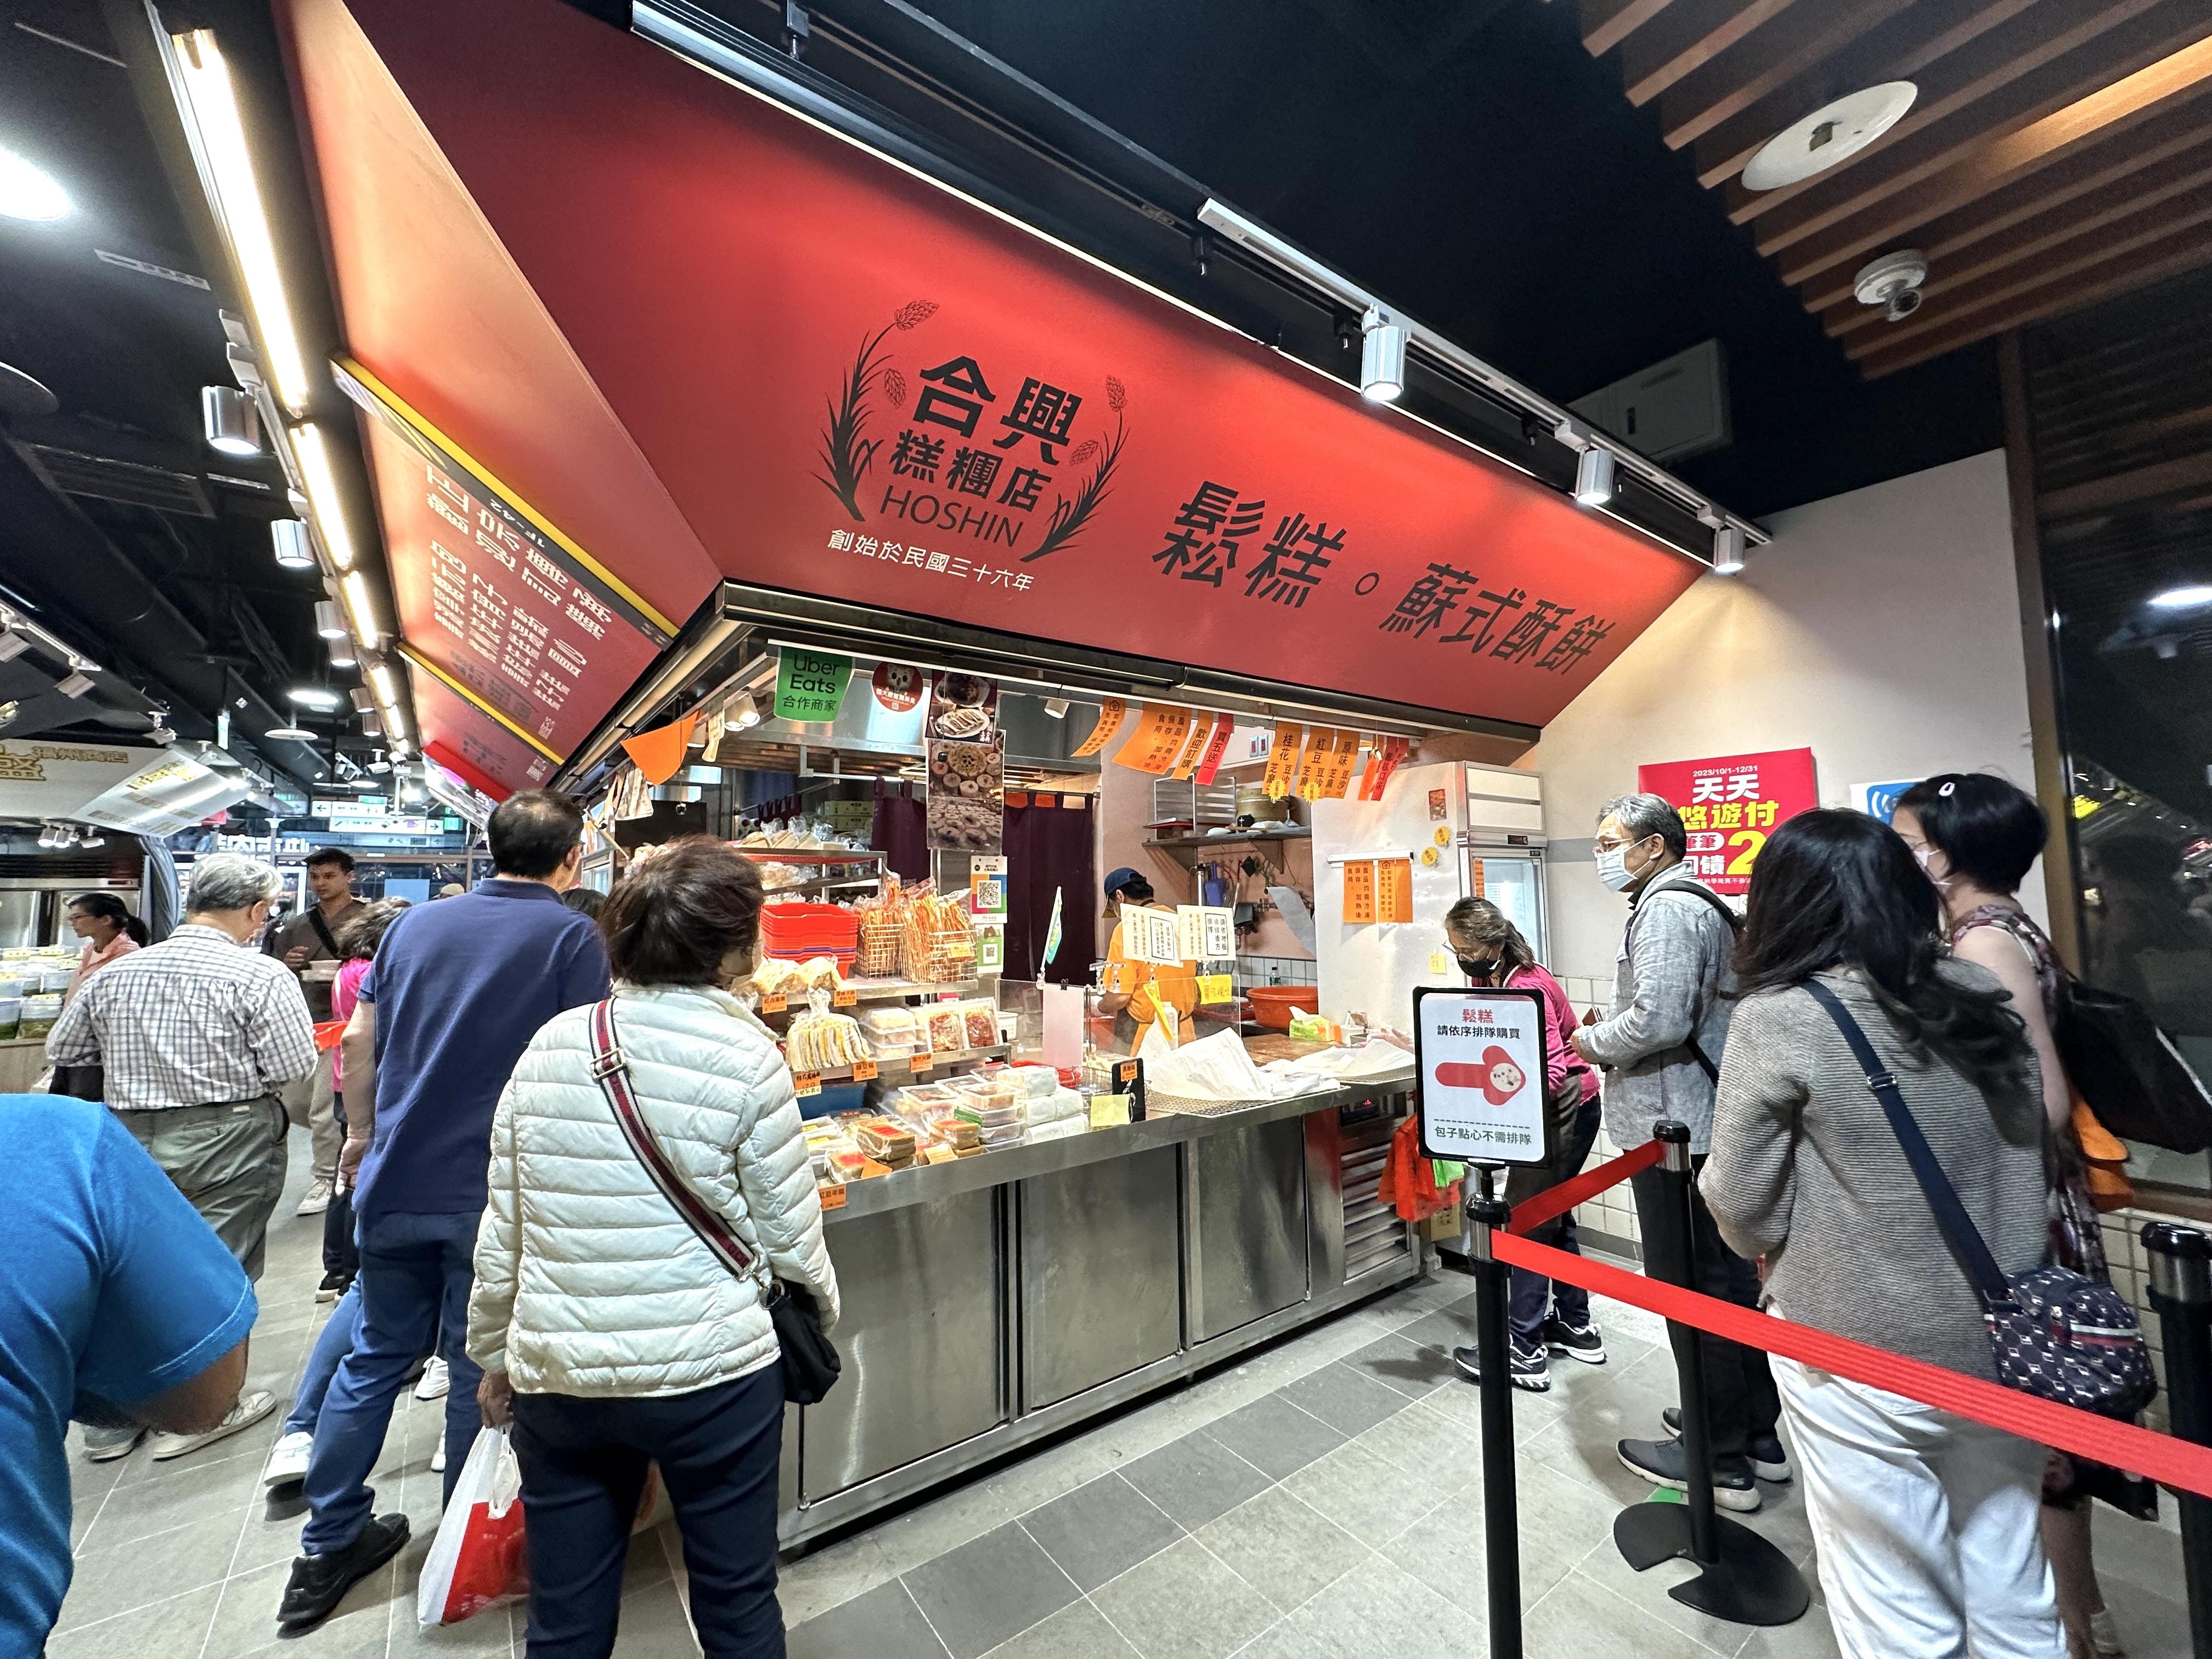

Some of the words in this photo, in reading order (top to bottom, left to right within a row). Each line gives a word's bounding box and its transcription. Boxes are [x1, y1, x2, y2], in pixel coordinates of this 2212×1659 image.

[912, 356, 1082, 465] 合興
[889, 428, 1052, 512] 糕糰店
[489, 498, 546, 548] 1F-42
[880, 486, 1023, 548] HOSHIN
[427, 465, 612, 624] 正宗傳承
[827, 528, 1035, 591] 創始於民國三十六年
[426, 493, 605, 641] 歡迎訂購
[1152, 481, 1346, 608] 鬆糕
[1378, 562, 1616, 675] 蘇式酥餅
[430, 540, 587, 665] 包子點心
[432, 557, 579, 678] 元宵湯圓
[794, 654, 840, 675] Uber
[789, 674, 836, 693] Eats
[783, 695, 836, 712] 合作商家
[1180, 729, 1207, 769] 歡迎訂購
[1203, 732, 1231, 769] 買五送一
[1279, 733, 1294, 760] 桂花
[1311, 737, 1326, 764] 紅豆
[1338, 742, 1352, 767] 原味
[1337, 770, 1350, 789] 豆沙
[1692, 765, 1758, 777] 2023/10/1-12/31
[1692, 774, 1760, 803] 天天
[1678, 800, 1779, 831] 悠遊付
[1726, 830, 1767, 874] 2
[1437, 1025, 1520, 1039] 請依序排隊購買
[1462, 1009, 1493, 1024] 鬆糕
[1435, 1126, 1532, 1146] 包子點心不需排隊
